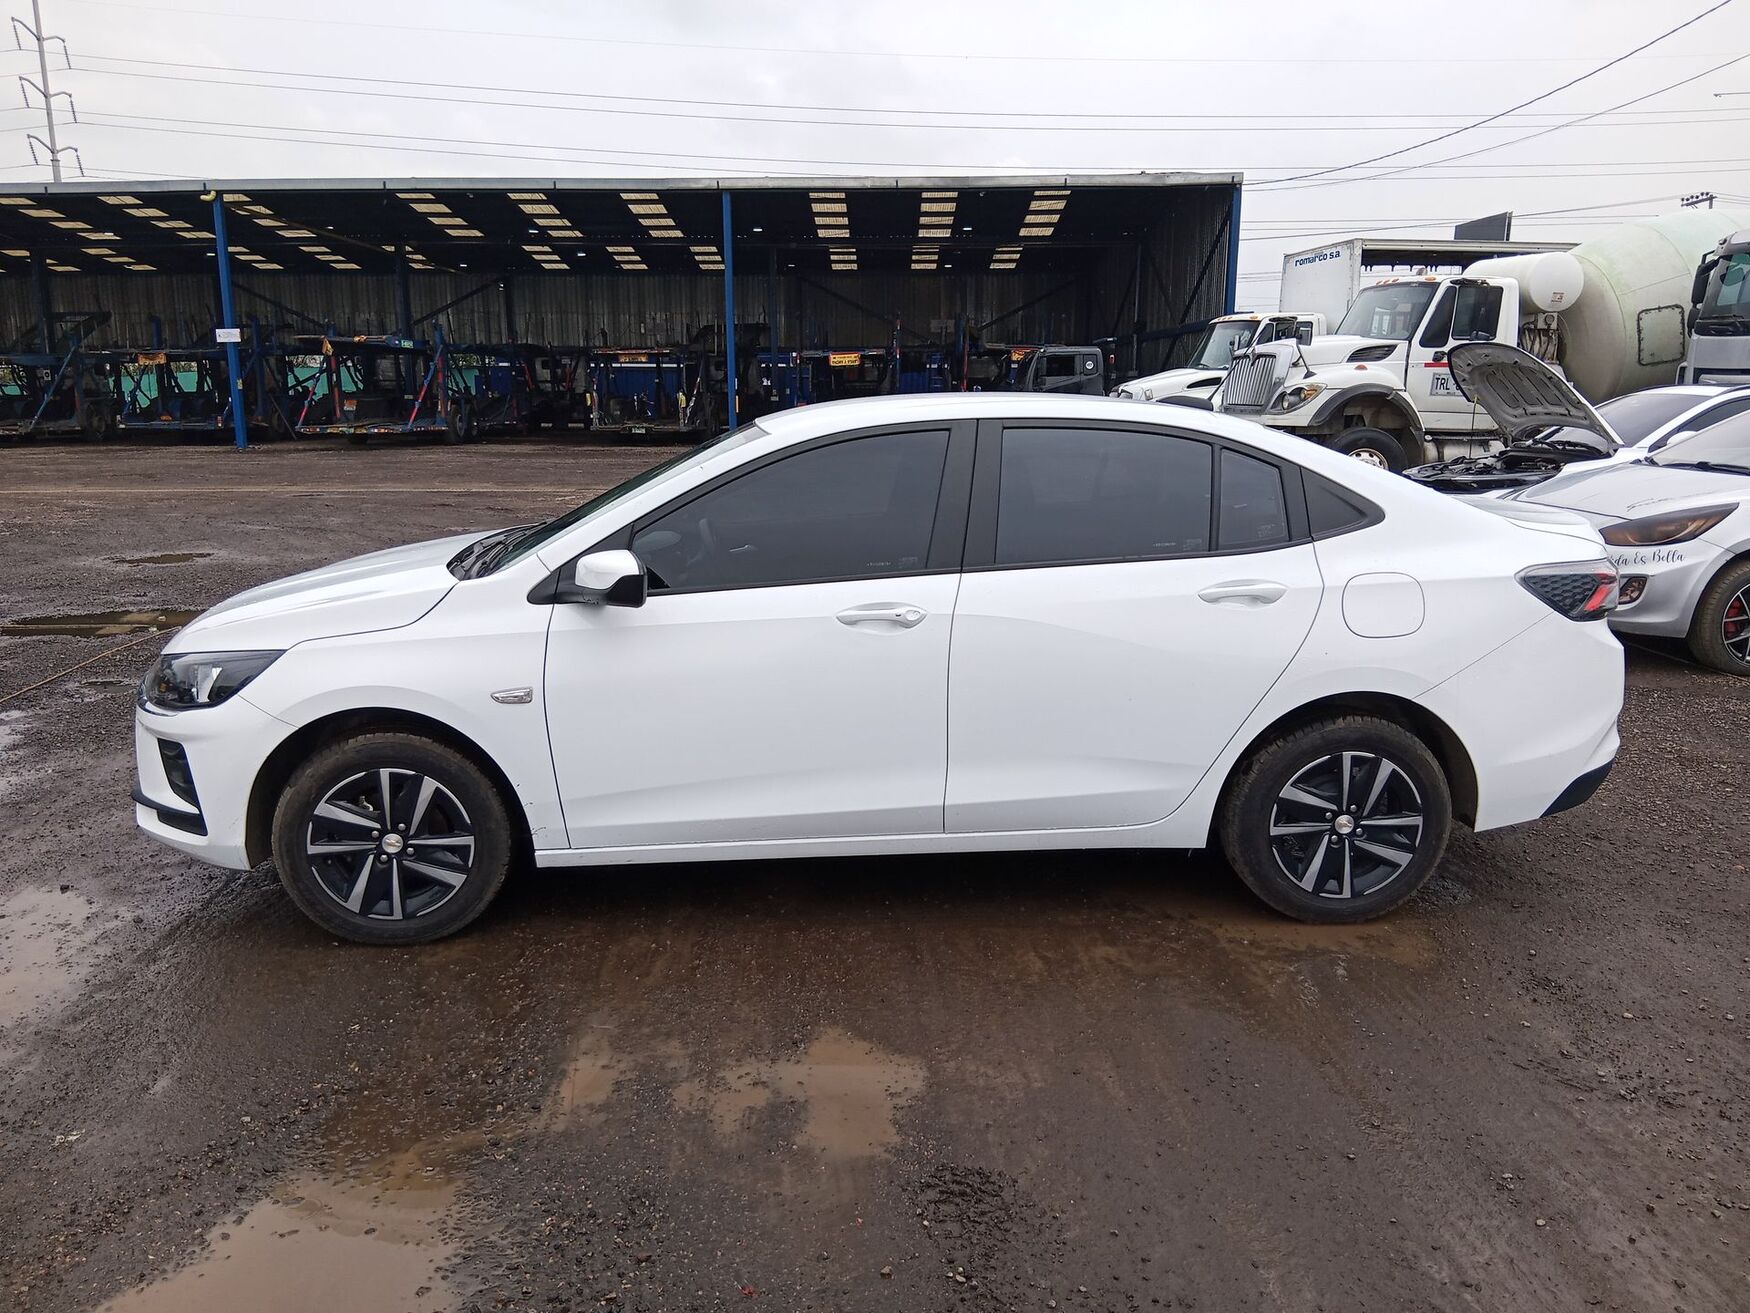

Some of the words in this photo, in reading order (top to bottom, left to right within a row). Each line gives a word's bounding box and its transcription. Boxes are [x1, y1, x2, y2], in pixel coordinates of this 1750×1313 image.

[1295, 253, 1328, 267] romarco
[1436, 377, 1450, 391] TRL
[1633, 551, 1647, 566] Es
[1652, 549, 1686, 563] Bella
